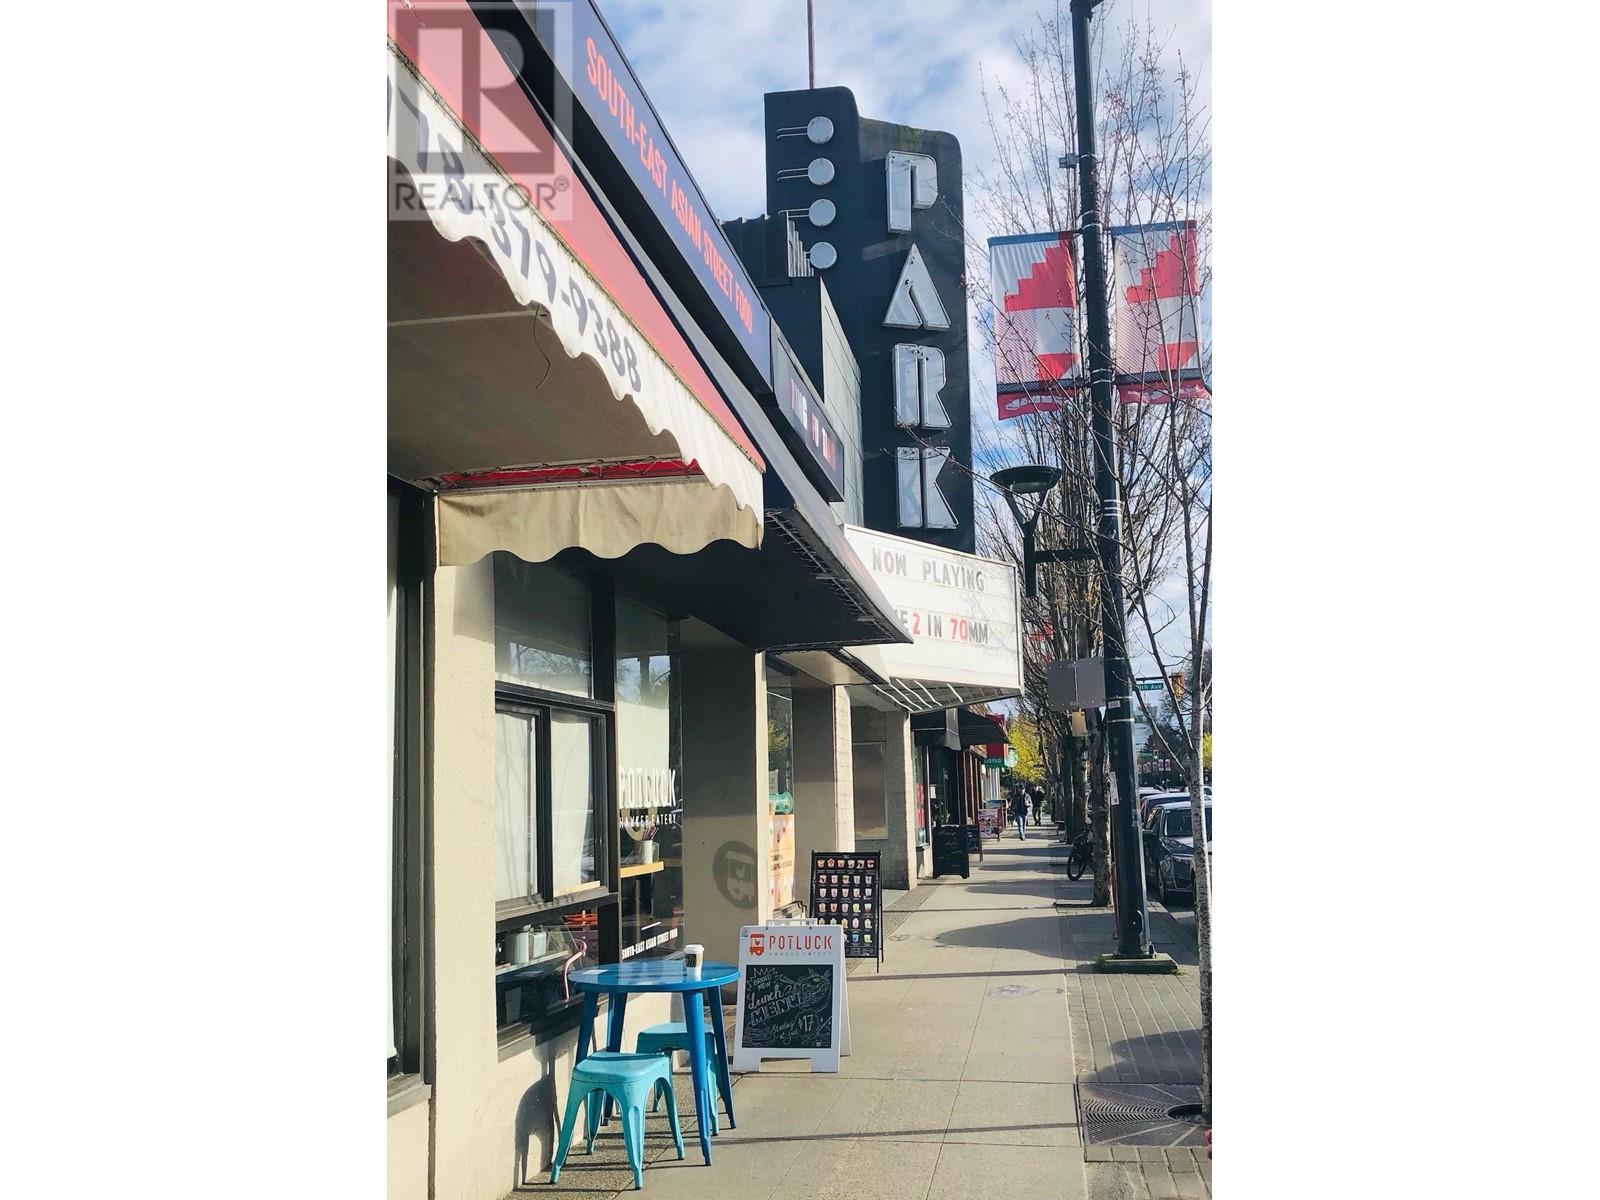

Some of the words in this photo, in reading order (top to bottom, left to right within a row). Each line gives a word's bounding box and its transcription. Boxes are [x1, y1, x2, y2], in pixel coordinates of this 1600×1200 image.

[585, 36, 667, 197] SOUTH-EAST
[671, 178, 702, 252] ASIAN
[703, 230, 733, 302] STREET
[735, 281, 752, 334] FOOD
[387, 74, 641, 393] 78-379-9388
[882, 150, 960, 530] PARK
[872, 547, 907, 577] NOW
[923, 560, 985, 591] PLAYING
[894, 609, 909, 633] E
[912, 611, 921, 635] 2
[927, 614, 943, 638] IN
[950, 617, 989, 645] 70MM
[619, 767, 677, 809] POTLUCK
[651, 813, 677, 827] EATERY
[769, 935, 832, 950] POTLUCK
[747, 984, 784, 1010] Lunch
